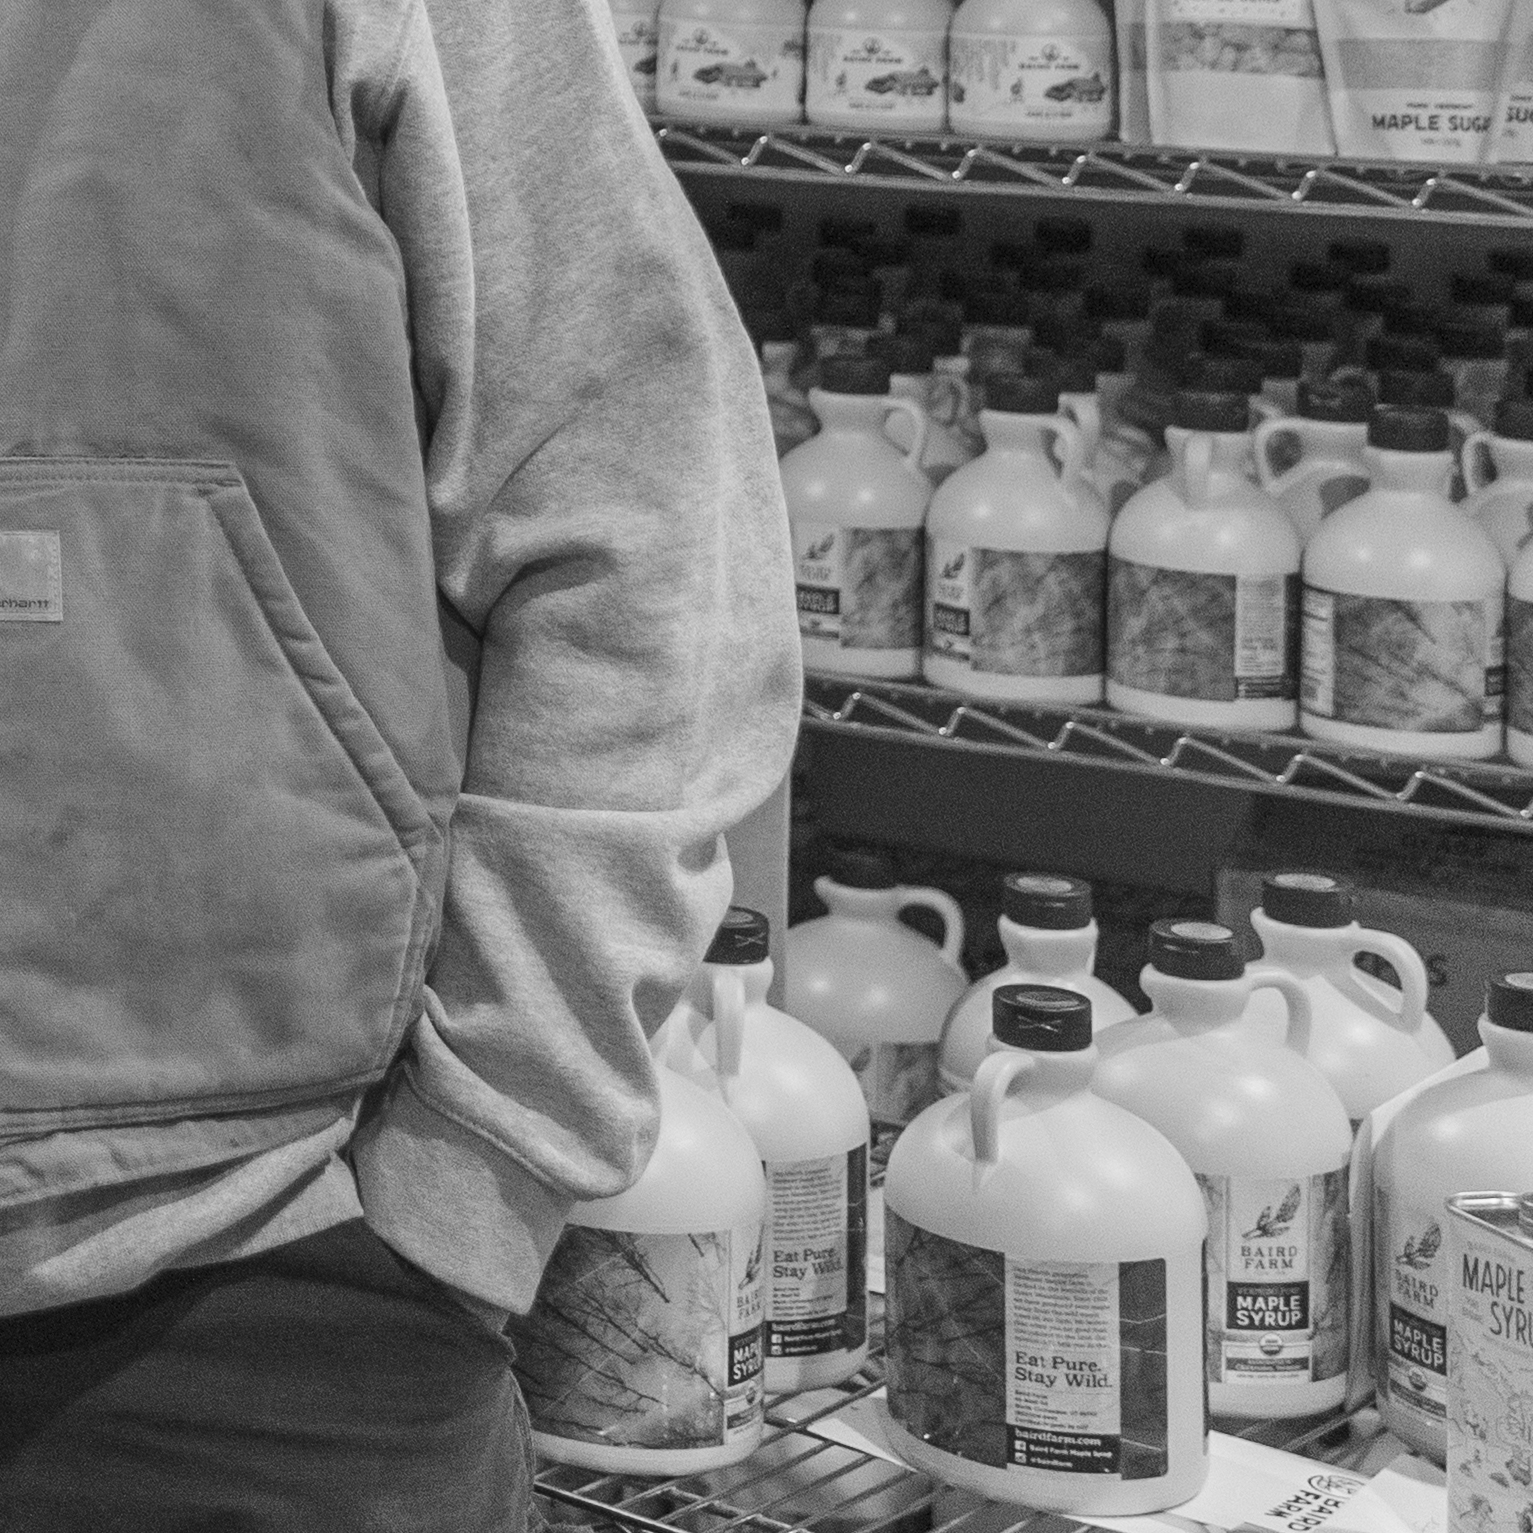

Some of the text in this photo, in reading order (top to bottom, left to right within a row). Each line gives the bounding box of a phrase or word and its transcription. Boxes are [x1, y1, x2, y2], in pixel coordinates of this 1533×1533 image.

[1372, 114, 1440, 131] MAPLE
[774, 1250, 799, 1263] Eat
[1241, 1246, 1298, 1258] BAIRD
[773, 1265, 806, 1280] Stay
[1245, 1258, 1293, 1269] FARM
[1396, 1269, 1438, 1297] BAIRD
[1463, 1254, 1525, 1304] MAPLE
[1237, 1296, 1301, 1311] MAPLE
[1398, 1282, 1434, 1309] FARM
[1237, 1310, 1301, 1326] SYRUP
[1393, 1319, 1443, 1353] MAPLE
[1015, 1351, 1101, 1372] Eat Pure.
[1394, 1335, 1443, 1368] SYRUP
[1014, 1367, 1112, 1388] Stay Wild.
[1015, 1428, 1101, 1447] bairdfarm.com
[1265, 1489, 1320, 1519] FARM
[1288, 1497, 1343, 1533] BAIRD
